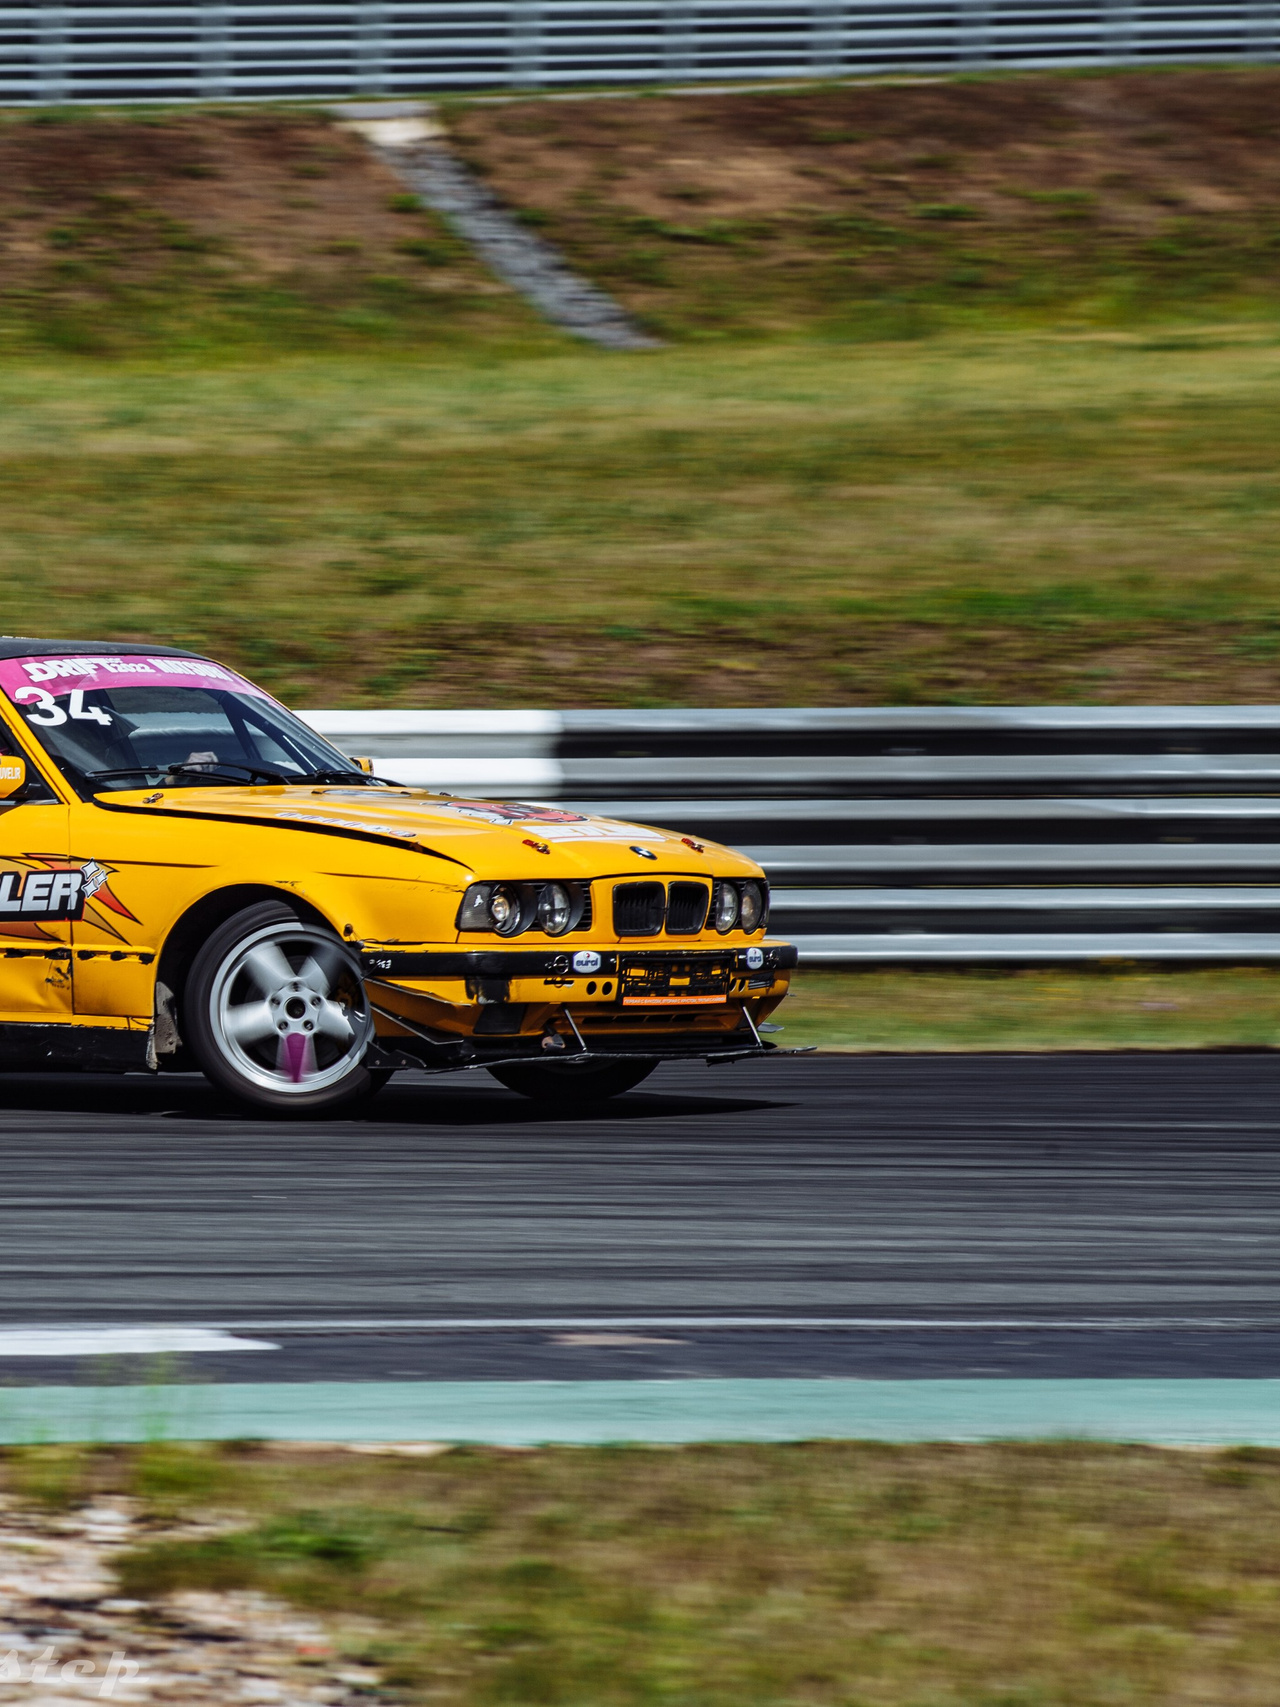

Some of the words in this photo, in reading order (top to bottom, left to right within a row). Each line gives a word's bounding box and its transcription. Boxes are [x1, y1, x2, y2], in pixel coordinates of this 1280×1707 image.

[22, 658, 115, 682] DRIFT
[14, 686, 113, 726] 34
[576, 957, 599, 966] eurol
